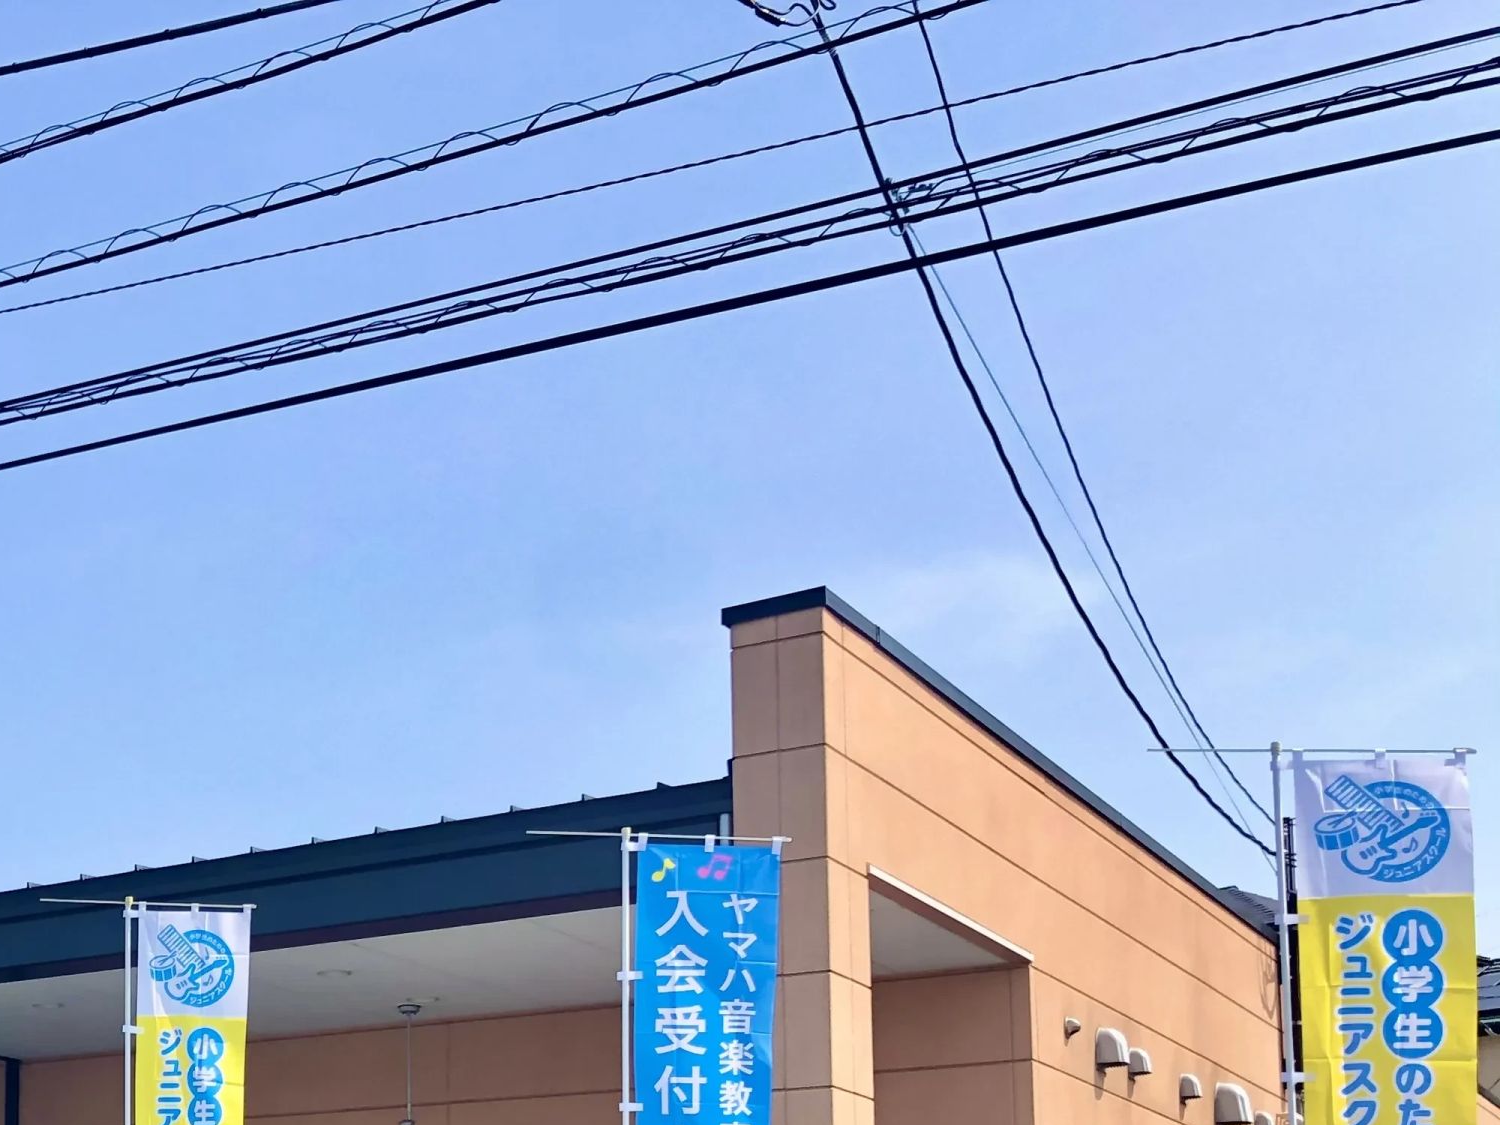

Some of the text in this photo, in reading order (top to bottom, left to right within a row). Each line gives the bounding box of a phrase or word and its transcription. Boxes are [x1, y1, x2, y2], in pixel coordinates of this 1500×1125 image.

[1383, 826, 1447, 879] ジュニアスクール
